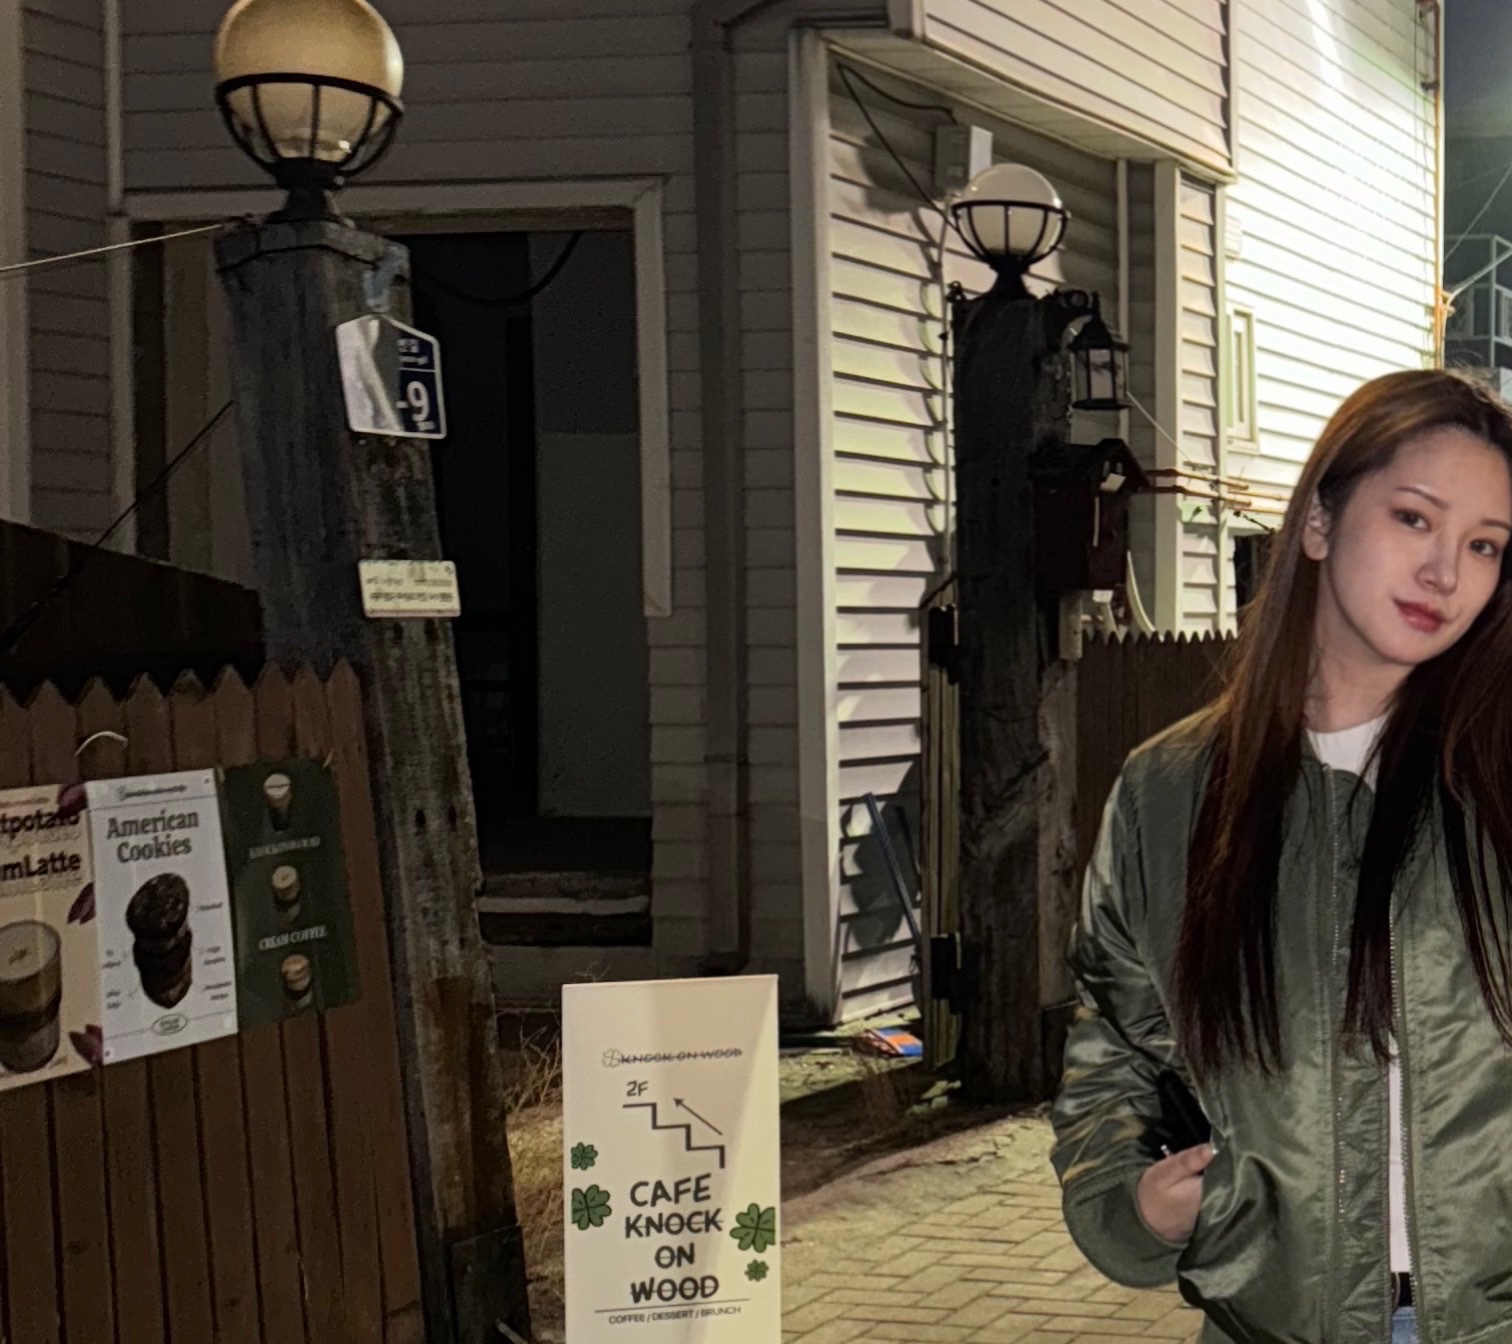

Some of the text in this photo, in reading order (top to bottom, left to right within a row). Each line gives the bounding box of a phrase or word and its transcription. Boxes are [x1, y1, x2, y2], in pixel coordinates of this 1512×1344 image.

[107, 808, 199, 840] American
[117, 834, 192, 864] Cookies
[626, 1079, 649, 1097] 2F
[629, 1173, 712, 1207] CAFE
[624, 1208, 724, 1238] KNOCK
[654, 1243, 696, 1269] ON
[630, 1274, 720, 1304] WOOD
[608, 1313, 646, 1325] COFFEE
[652, 1309, 695, 1322] DESSERT
[700, 1305, 742, 1318] BRUNCH
